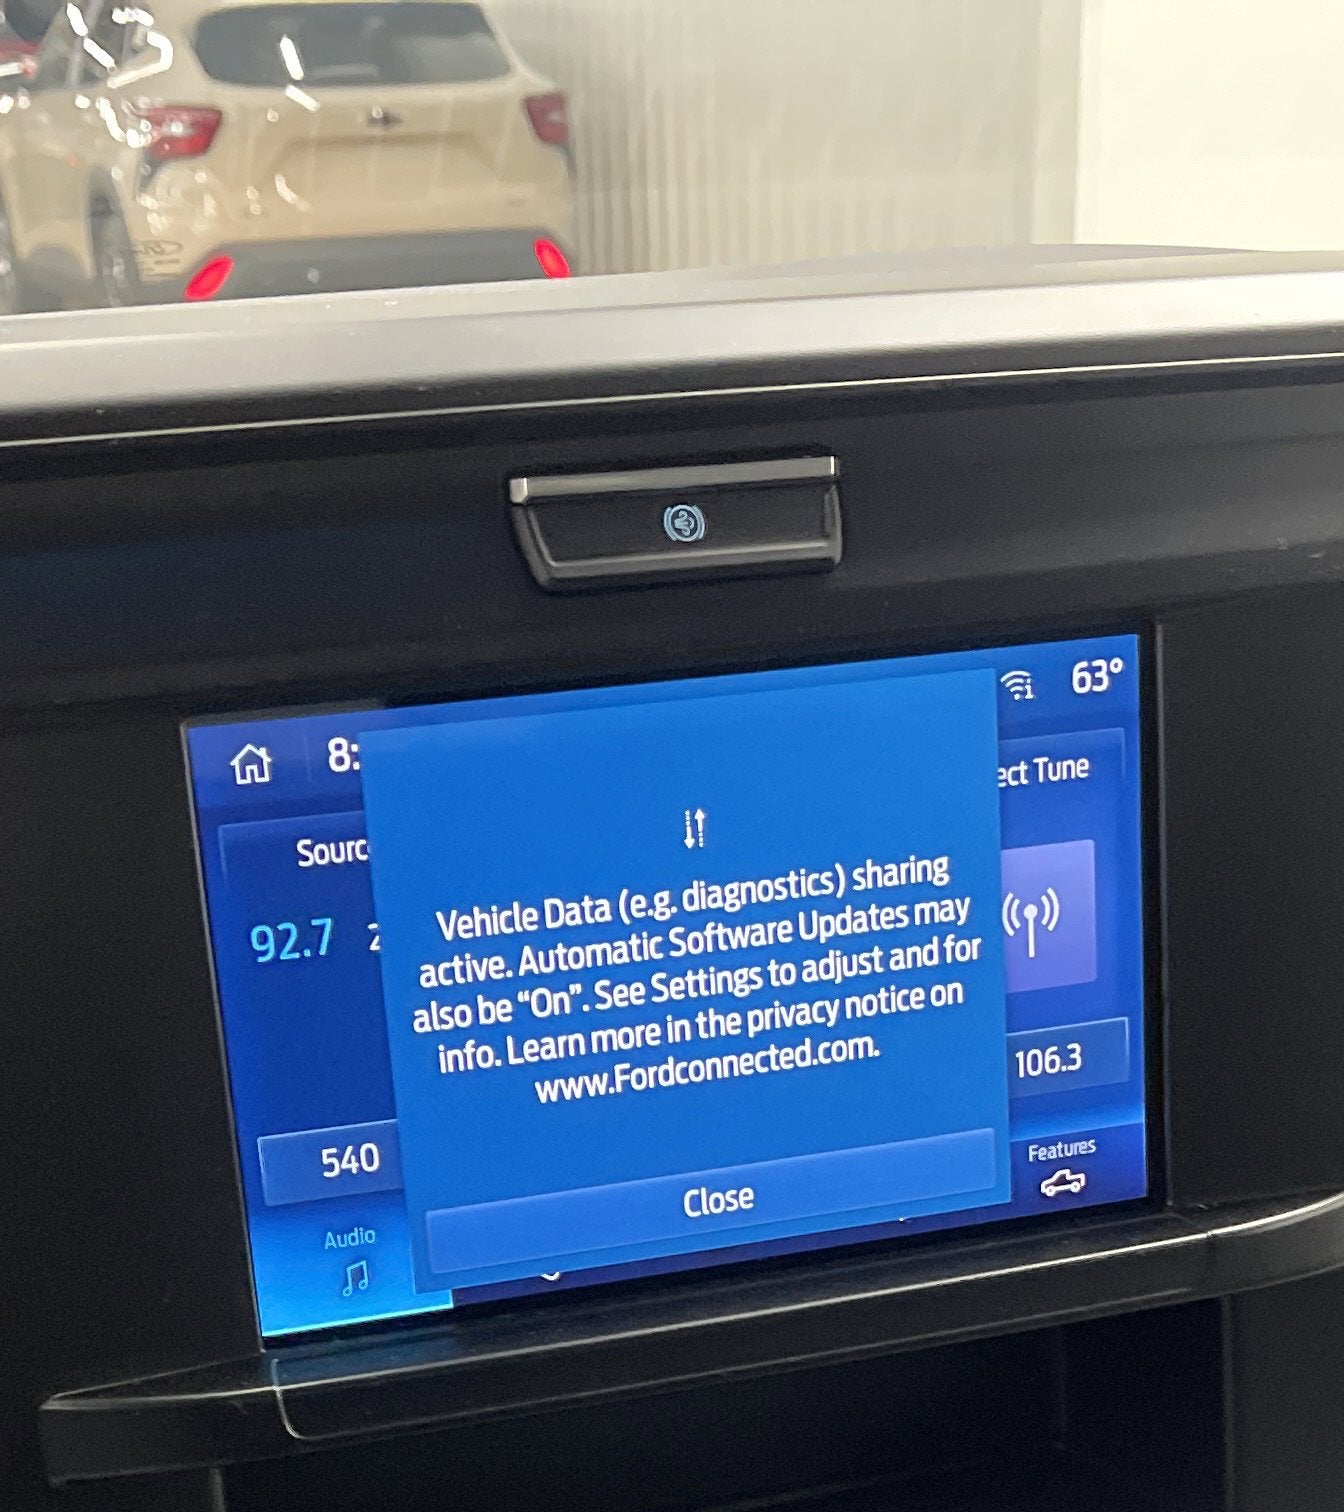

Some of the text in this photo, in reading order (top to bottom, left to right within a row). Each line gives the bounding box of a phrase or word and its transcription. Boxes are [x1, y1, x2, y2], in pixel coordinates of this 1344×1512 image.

[1032, 756, 1090, 784] Tune
[296, 838, 370, 867] Sourc
[436, 855, 950, 942] Vehicle Data (e.g. diagnostics) sharing
[250, 917, 333, 963] 92.7
[419, 897, 971, 988] active. Automatic Software Updates may
[413, 1000, 472, 1033] also
[478, 994, 513, 1026] be
[594, 978, 646, 1010] See
[651, 965, 764, 1003] Settings
[767, 959, 798, 986] to
[801, 946, 884, 984] adjust
[889, 942, 939, 972] and
[943, 935, 983, 966] for
[438, 980, 965, 1074] info. Learn more in the privacy notice on
[534, 1034, 881, 1104] www.Fordconnected.com.
[1014, 1042, 1084, 1079] 106.3
[321, 1142, 380, 1178] 540
[1028, 1136, 1097, 1163] Features
[682, 1185, 756, 1219] Close
[324, 1227, 376, 1251] Audio
